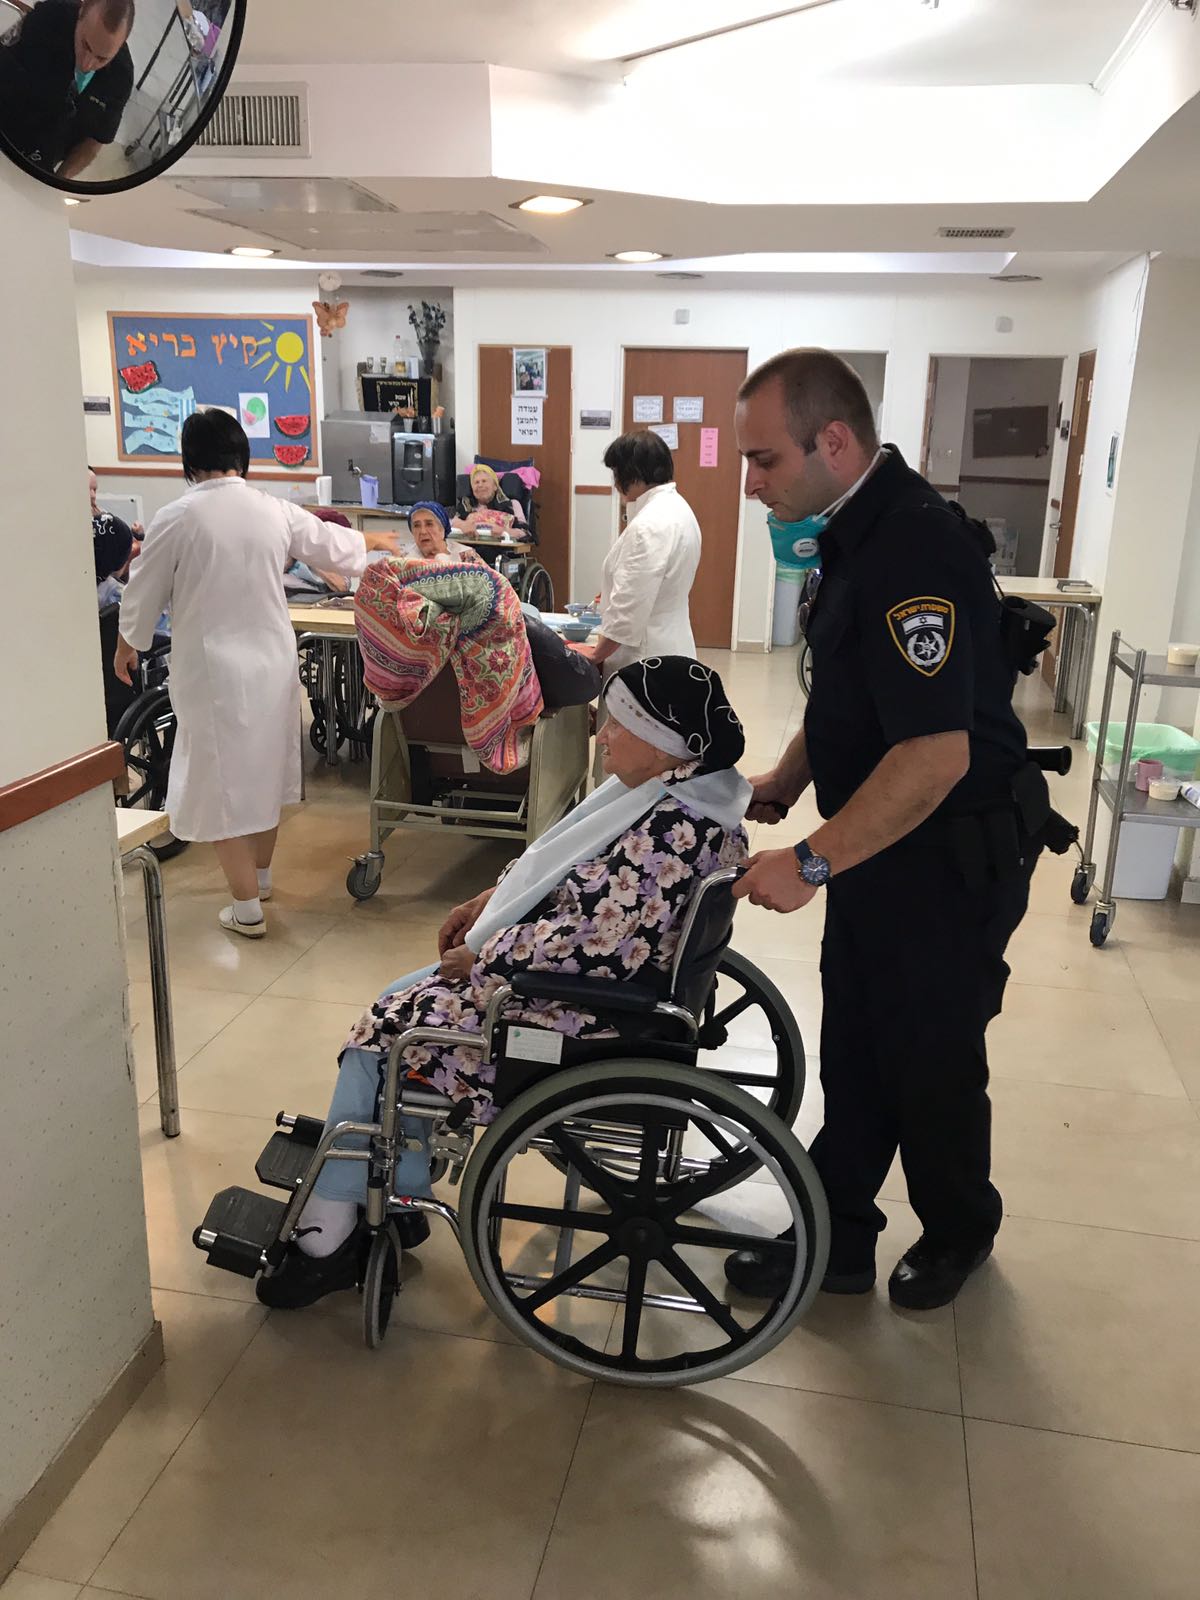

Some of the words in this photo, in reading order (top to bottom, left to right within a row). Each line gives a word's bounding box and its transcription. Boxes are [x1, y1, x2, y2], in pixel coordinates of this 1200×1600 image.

[126, 332, 197, 358] בריא
[211, 332, 257, 366] קיץ
[893, 605, 920, 620] ישראל
[920, 603, 949, 614] משטרת
